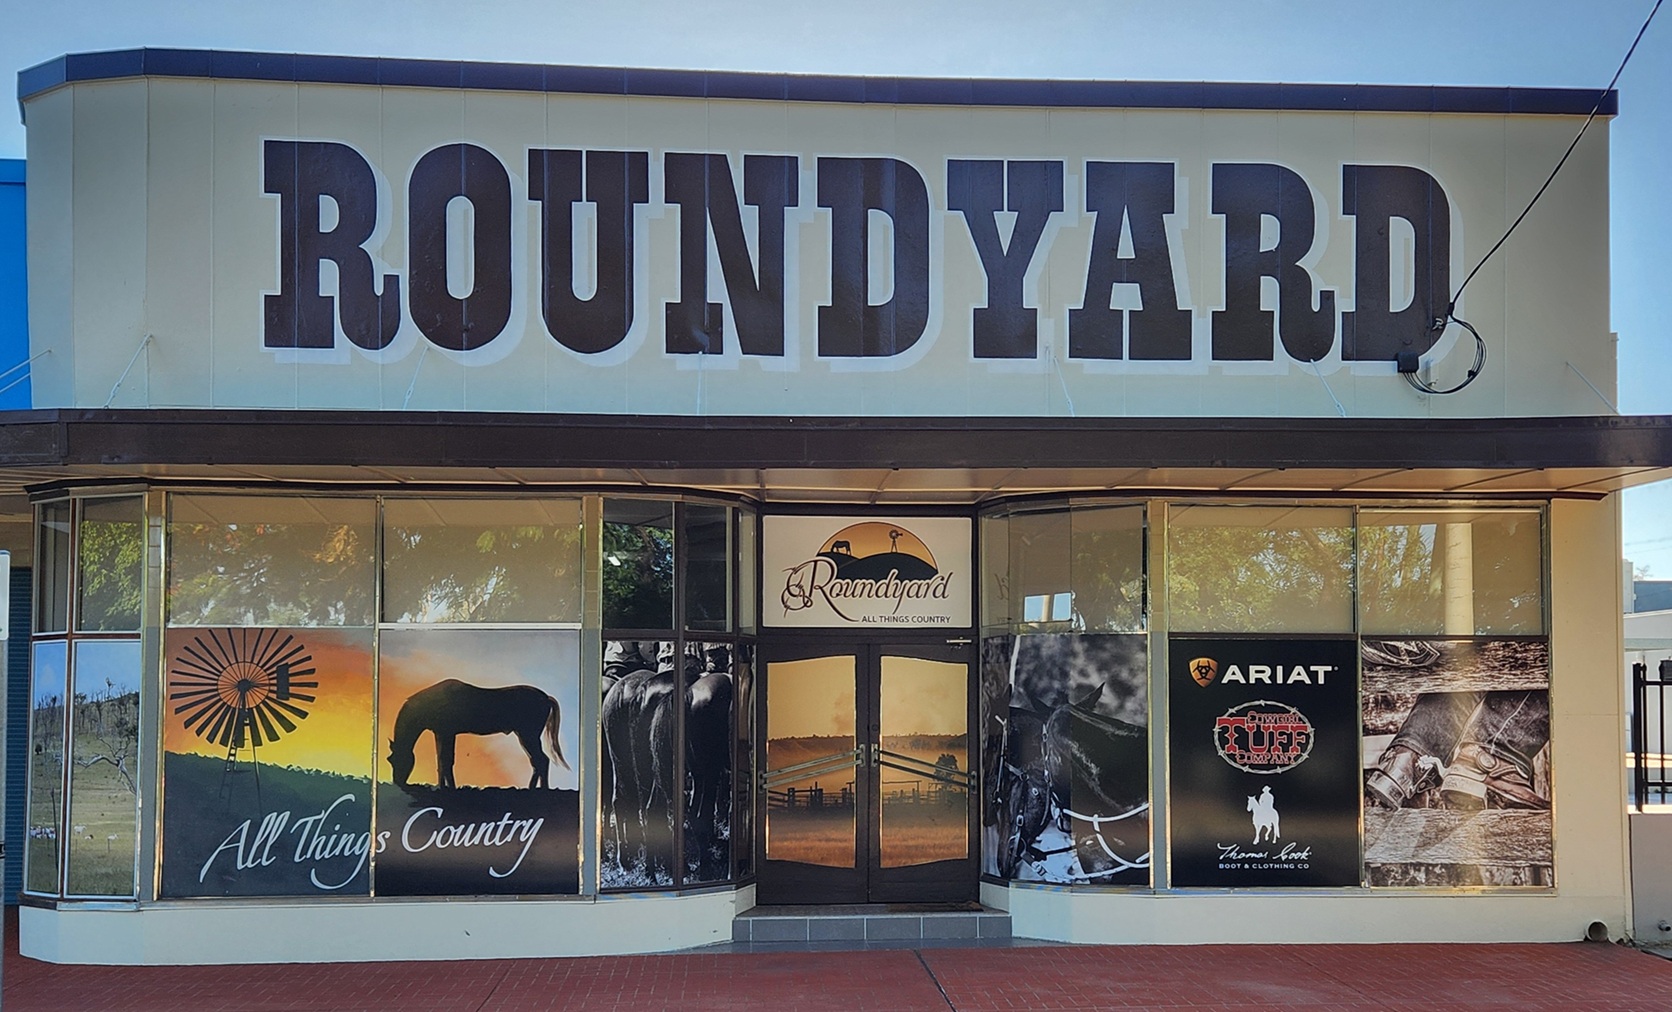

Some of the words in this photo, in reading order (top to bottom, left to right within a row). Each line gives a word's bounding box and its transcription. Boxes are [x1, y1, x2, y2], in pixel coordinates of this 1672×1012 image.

[263, 139, 1452, 363] ROUNDYARD
[781, 559, 953, 621] Roundyard
[862, 615, 877, 623] ALL
[879, 615, 909, 623] THINGS
[911, 615, 951, 623] COUNTRY
[1221, 665, 1332, 684] ARIAT
[1216, 716, 1309, 754] TUFF
[199, 811, 290, 883] All
[290, 793, 391, 889] Things
[401, 807, 545, 877] Country
[1217, 842, 1269, 860] Thomas
